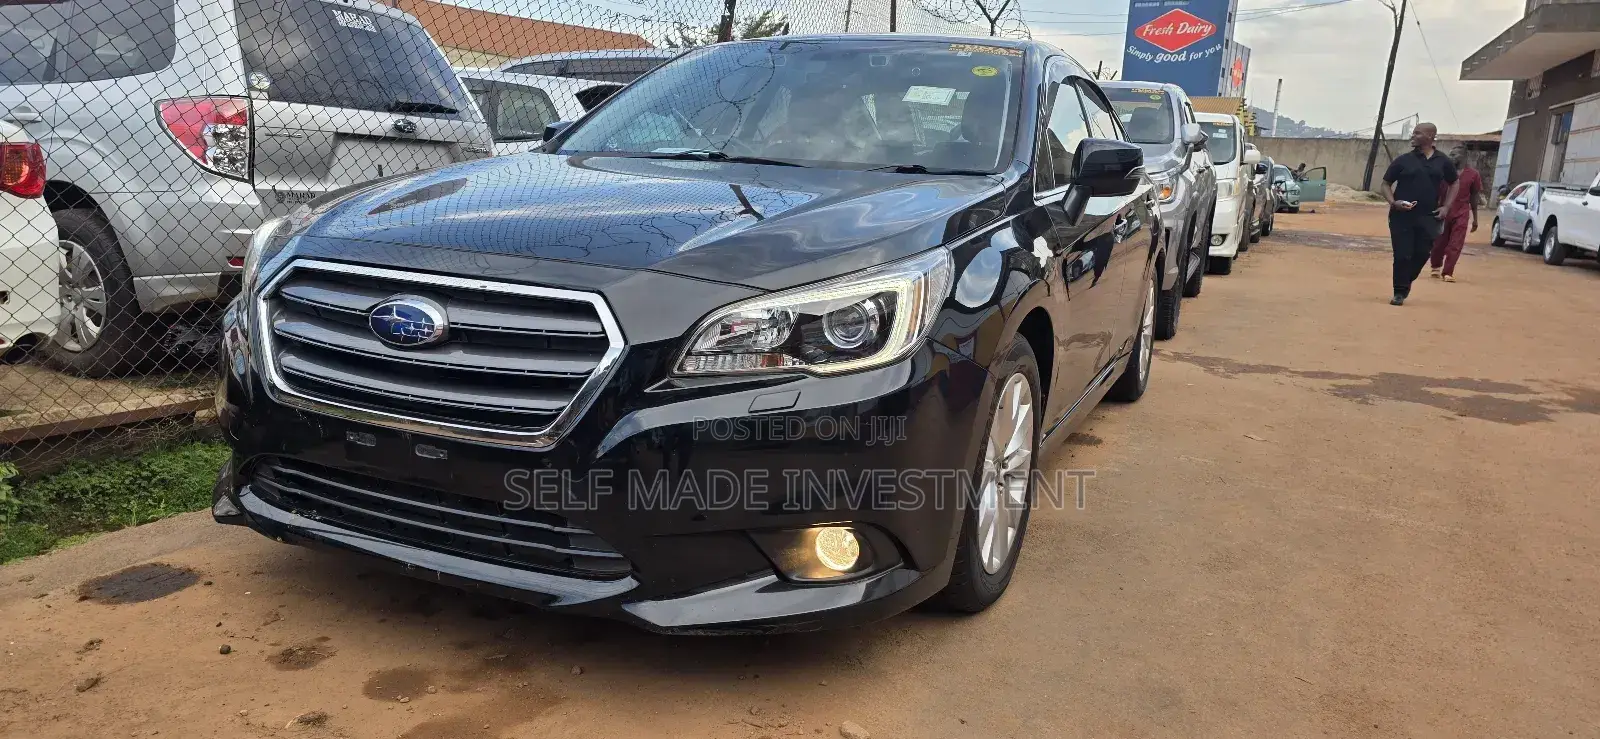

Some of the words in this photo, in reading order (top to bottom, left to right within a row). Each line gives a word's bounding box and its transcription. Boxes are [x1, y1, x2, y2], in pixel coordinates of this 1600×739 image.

[1143, 22, 1174, 37] Fresh
[1176, 21, 1213, 37] Dairy
[1126, 45, 1154, 62] Simply
[1154, 51, 1187, 64] good
[1189, 51, 1204, 62] for
[1205, 43, 1222, 58] you
